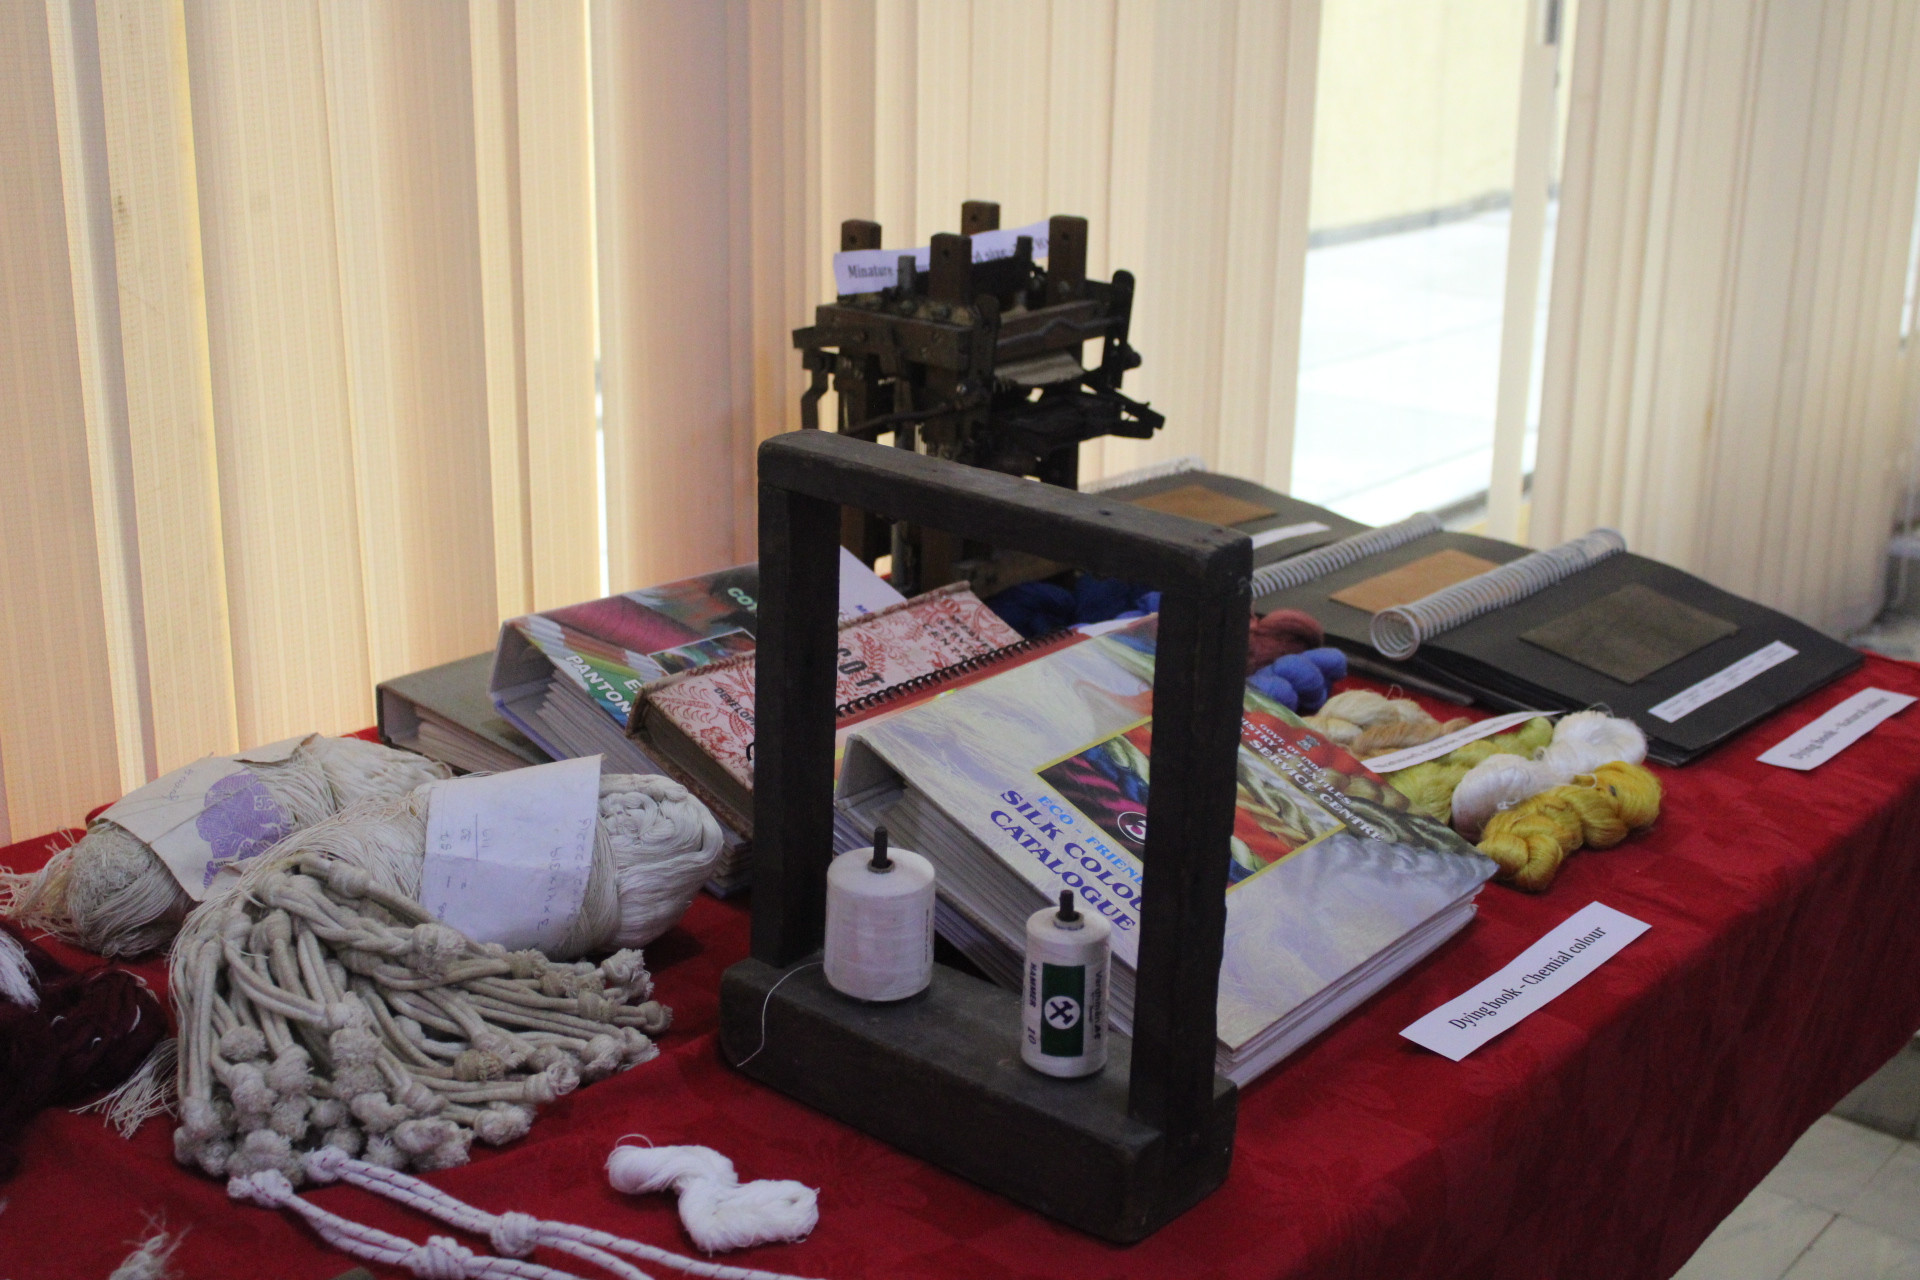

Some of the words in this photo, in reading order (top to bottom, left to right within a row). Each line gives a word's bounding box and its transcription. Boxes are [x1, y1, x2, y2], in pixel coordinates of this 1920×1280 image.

[566, 655, 632, 719] PANTON
[624, 679, 642, 694] E
[1249, 739, 1317, 792] SERVICE
[1319, 793, 1385, 842] CENTRE
[1277, 747, 1295, 760] OF
[1296, 762, 1353, 806] TEXTILES
[1000, 790, 1064, 841] SILK
[1037, 796, 1074, 825] ECO
[990, 810, 1136, 931] CATALOGUE
[1029, 962, 1037, 1008] HAMMER
[1448, 1003, 1497, 1029] Dying
[1481, 988, 1522, 1010] book
[1521, 950, 1574, 985] Chemial
[1569, 926, 1606, 954] colour
